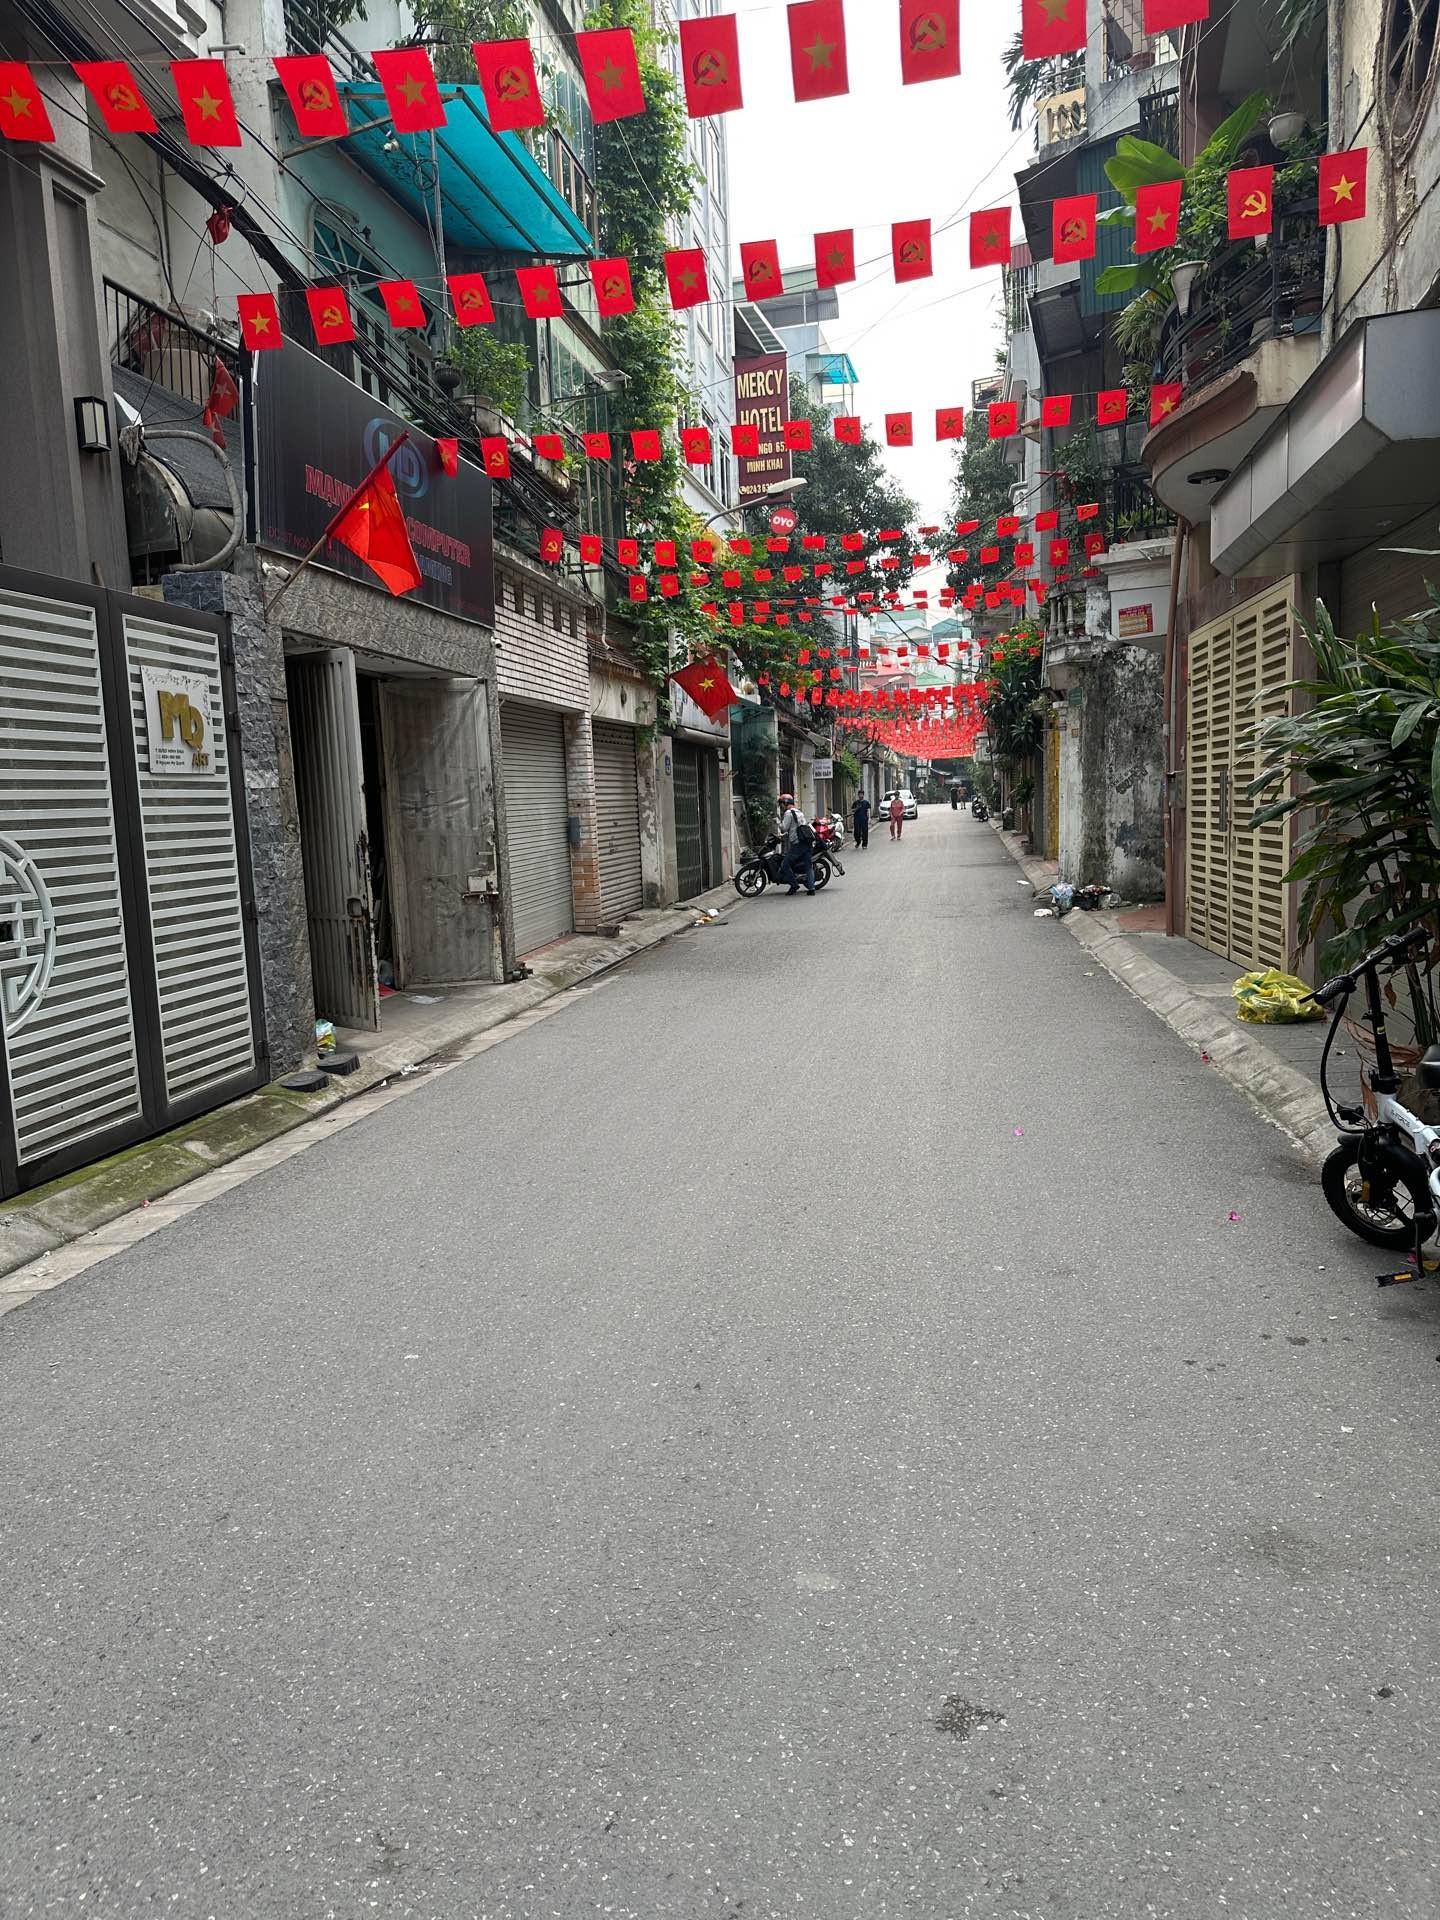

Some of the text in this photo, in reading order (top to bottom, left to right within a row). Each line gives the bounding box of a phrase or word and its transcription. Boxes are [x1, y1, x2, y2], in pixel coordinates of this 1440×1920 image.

[737, 369, 783, 399] MERCY
[740, 406, 784, 433] HOTEL
[746, 458, 783, 473] MINH KHAI
[772, 516, 794, 528] OYO
[406, 516, 471, 569] COMPUTER
[192, 752, 210, 767] ART
